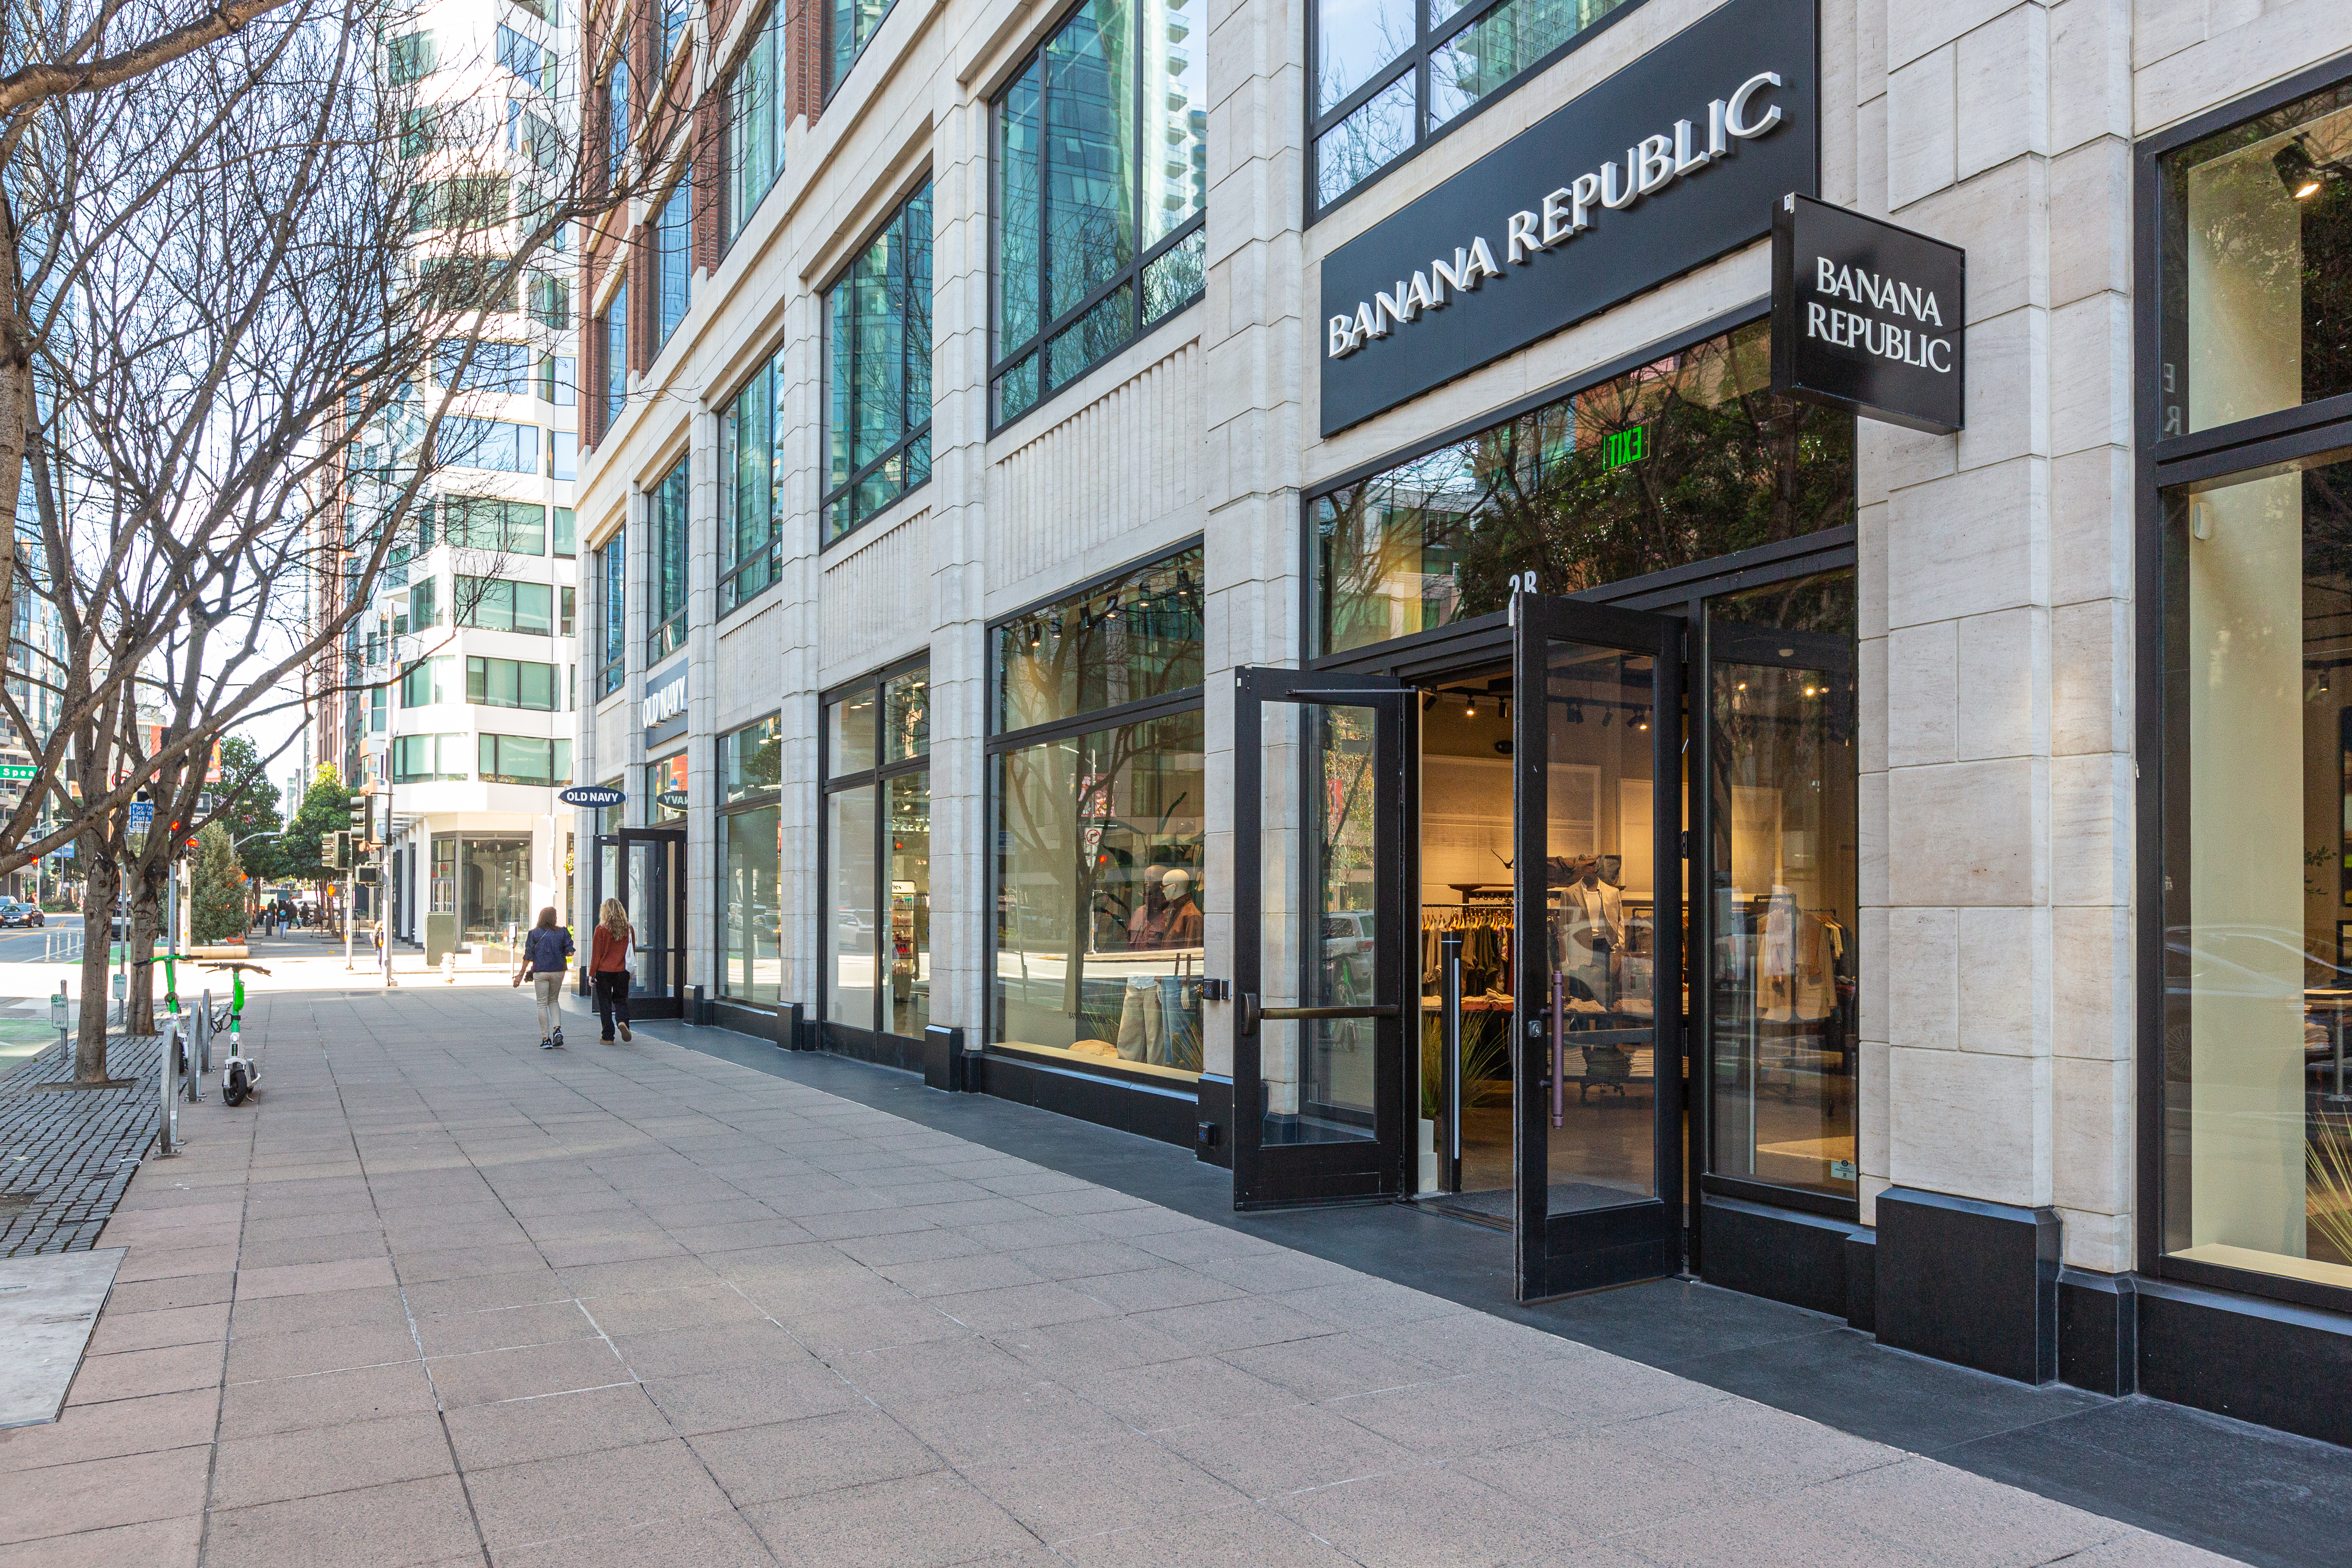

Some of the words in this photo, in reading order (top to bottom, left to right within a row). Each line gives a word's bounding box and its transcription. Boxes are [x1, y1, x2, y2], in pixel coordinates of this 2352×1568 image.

[1328, 236, 1499, 360] BANANA
[1507, 71, 1781, 264] REPUBLIC
[1816, 257, 1943, 327] BANANA
[1807, 302, 1951, 373] REPUBLIC
[642, 692, 661, 729] OLD
[660, 675, 686, 720] NAVY
[3, 768, 34, 777] Spea
[567, 792, 588, 801] OLD
[590, 792, 618, 802] NAVY
